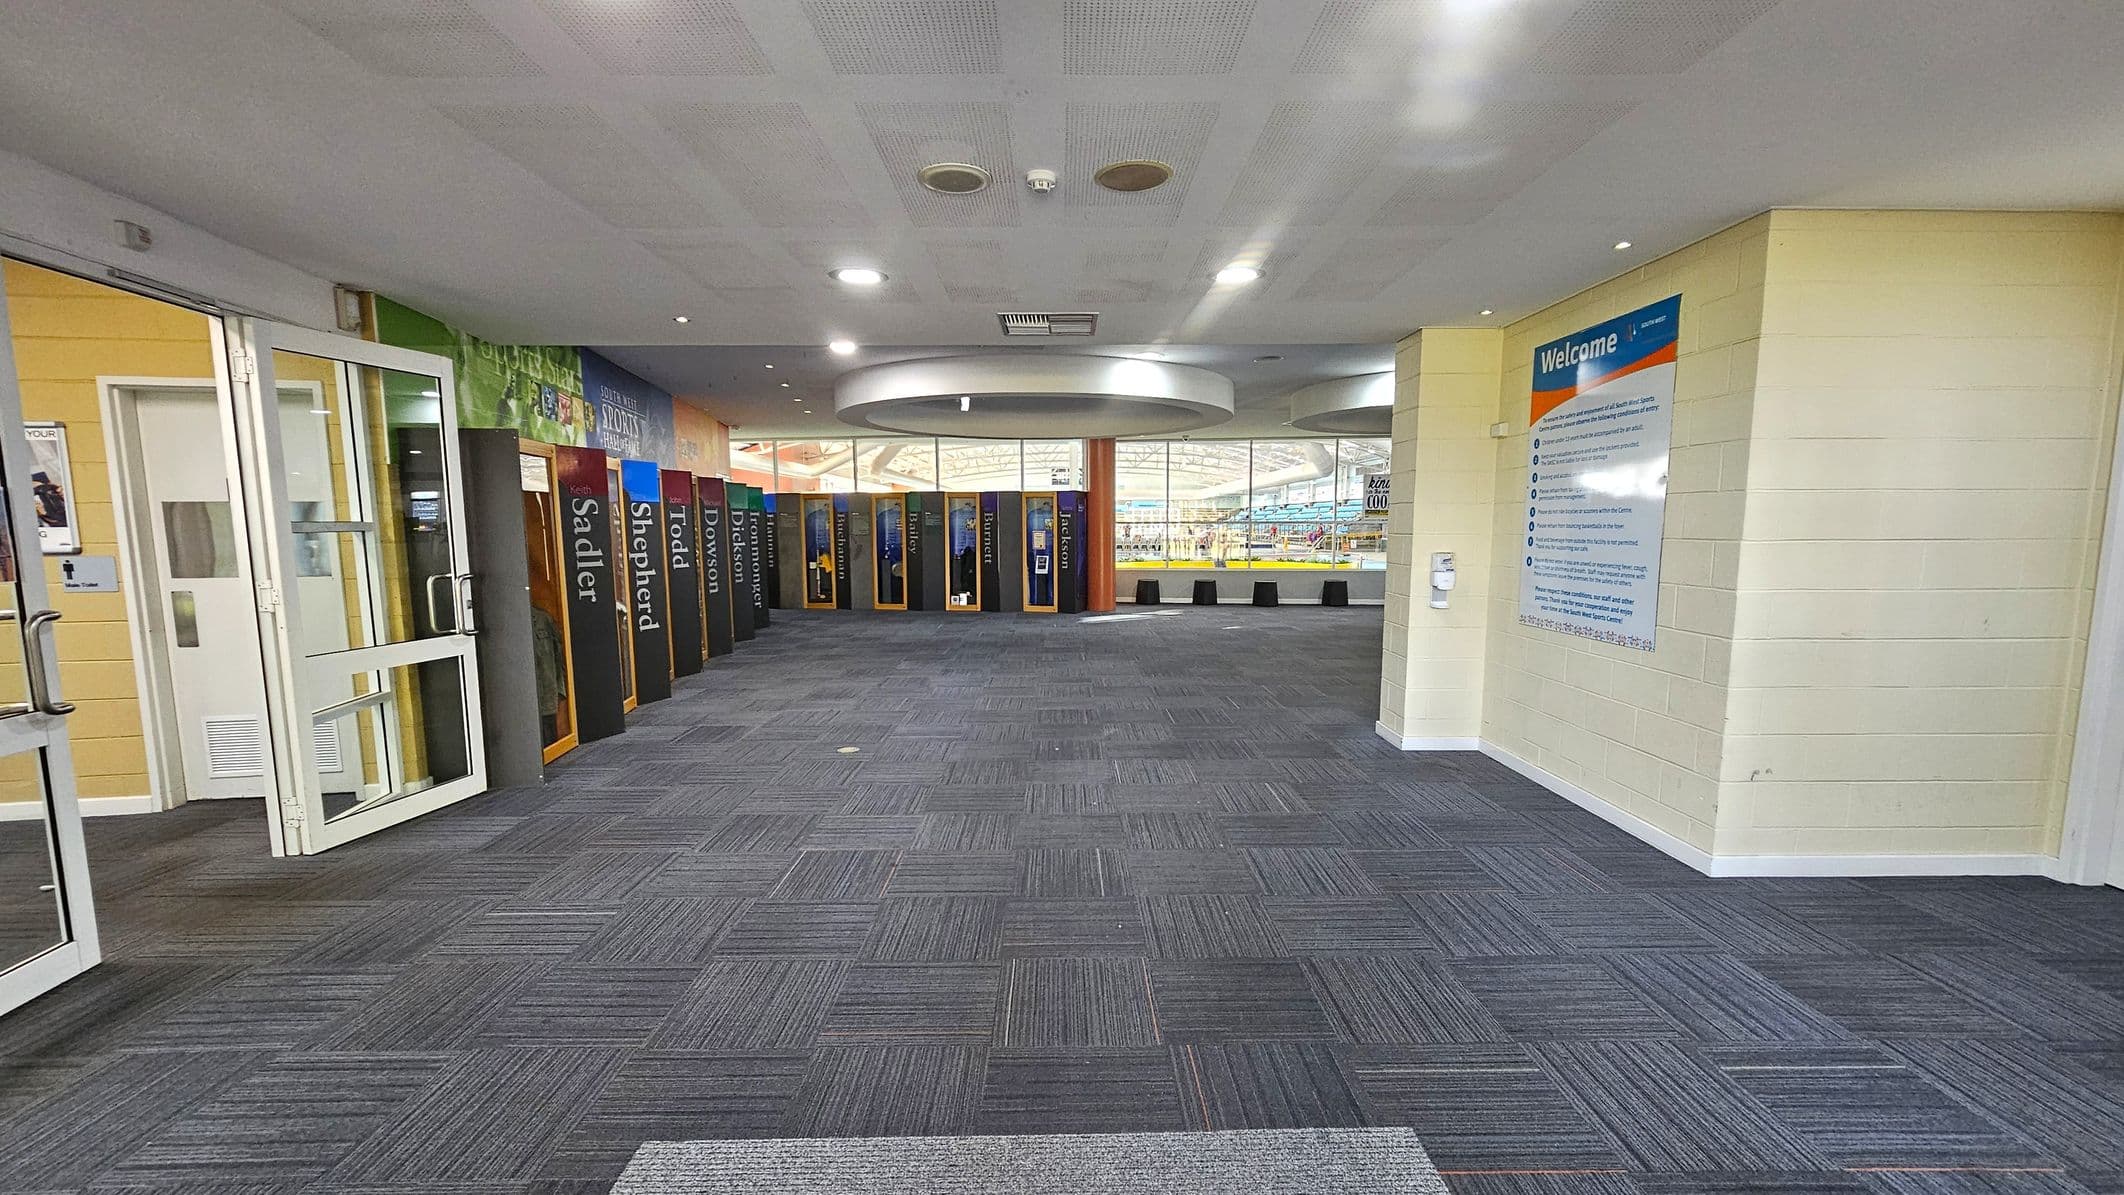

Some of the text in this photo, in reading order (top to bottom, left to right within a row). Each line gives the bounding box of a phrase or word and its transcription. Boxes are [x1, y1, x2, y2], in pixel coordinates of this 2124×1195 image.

[1641, 314, 1666, 329] SOUTH WEST
[1541, 333, 1618, 374] Welcome
[600, 385, 638, 410] SOUTH WEST
[1616, 400, 1628, 408] South
[1640, 394, 1655, 403] Sports
[1617, 408, 1639, 417] conditions
[26, 430, 57, 438] YOUR
[602, 404, 640, 438] SPORTS
[603, 431, 620, 451] HALL
[625, 436, 641, 457] FAME
[570, 485, 592, 495] Keith
[1367, 494, 1390, 509] COO
[571, 498, 604, 603] Sadler
[669, 505, 690, 569] Todd
[703, 507, 719, 595] Dowson
[731, 510, 746, 583] Dickson
[837, 513, 847, 580] Buchanan
[908, 513, 920, 554] Bailey
[984, 512, 994, 564] Burnett
[1059, 511, 1072, 569] Jackson
[629, 502, 660, 632] Shepherd
[749, 511, 764, 609] Ironmonger
[1585, 603, 1610, 611] cooperation
[1620, 608, 1633, 616] enjoy
